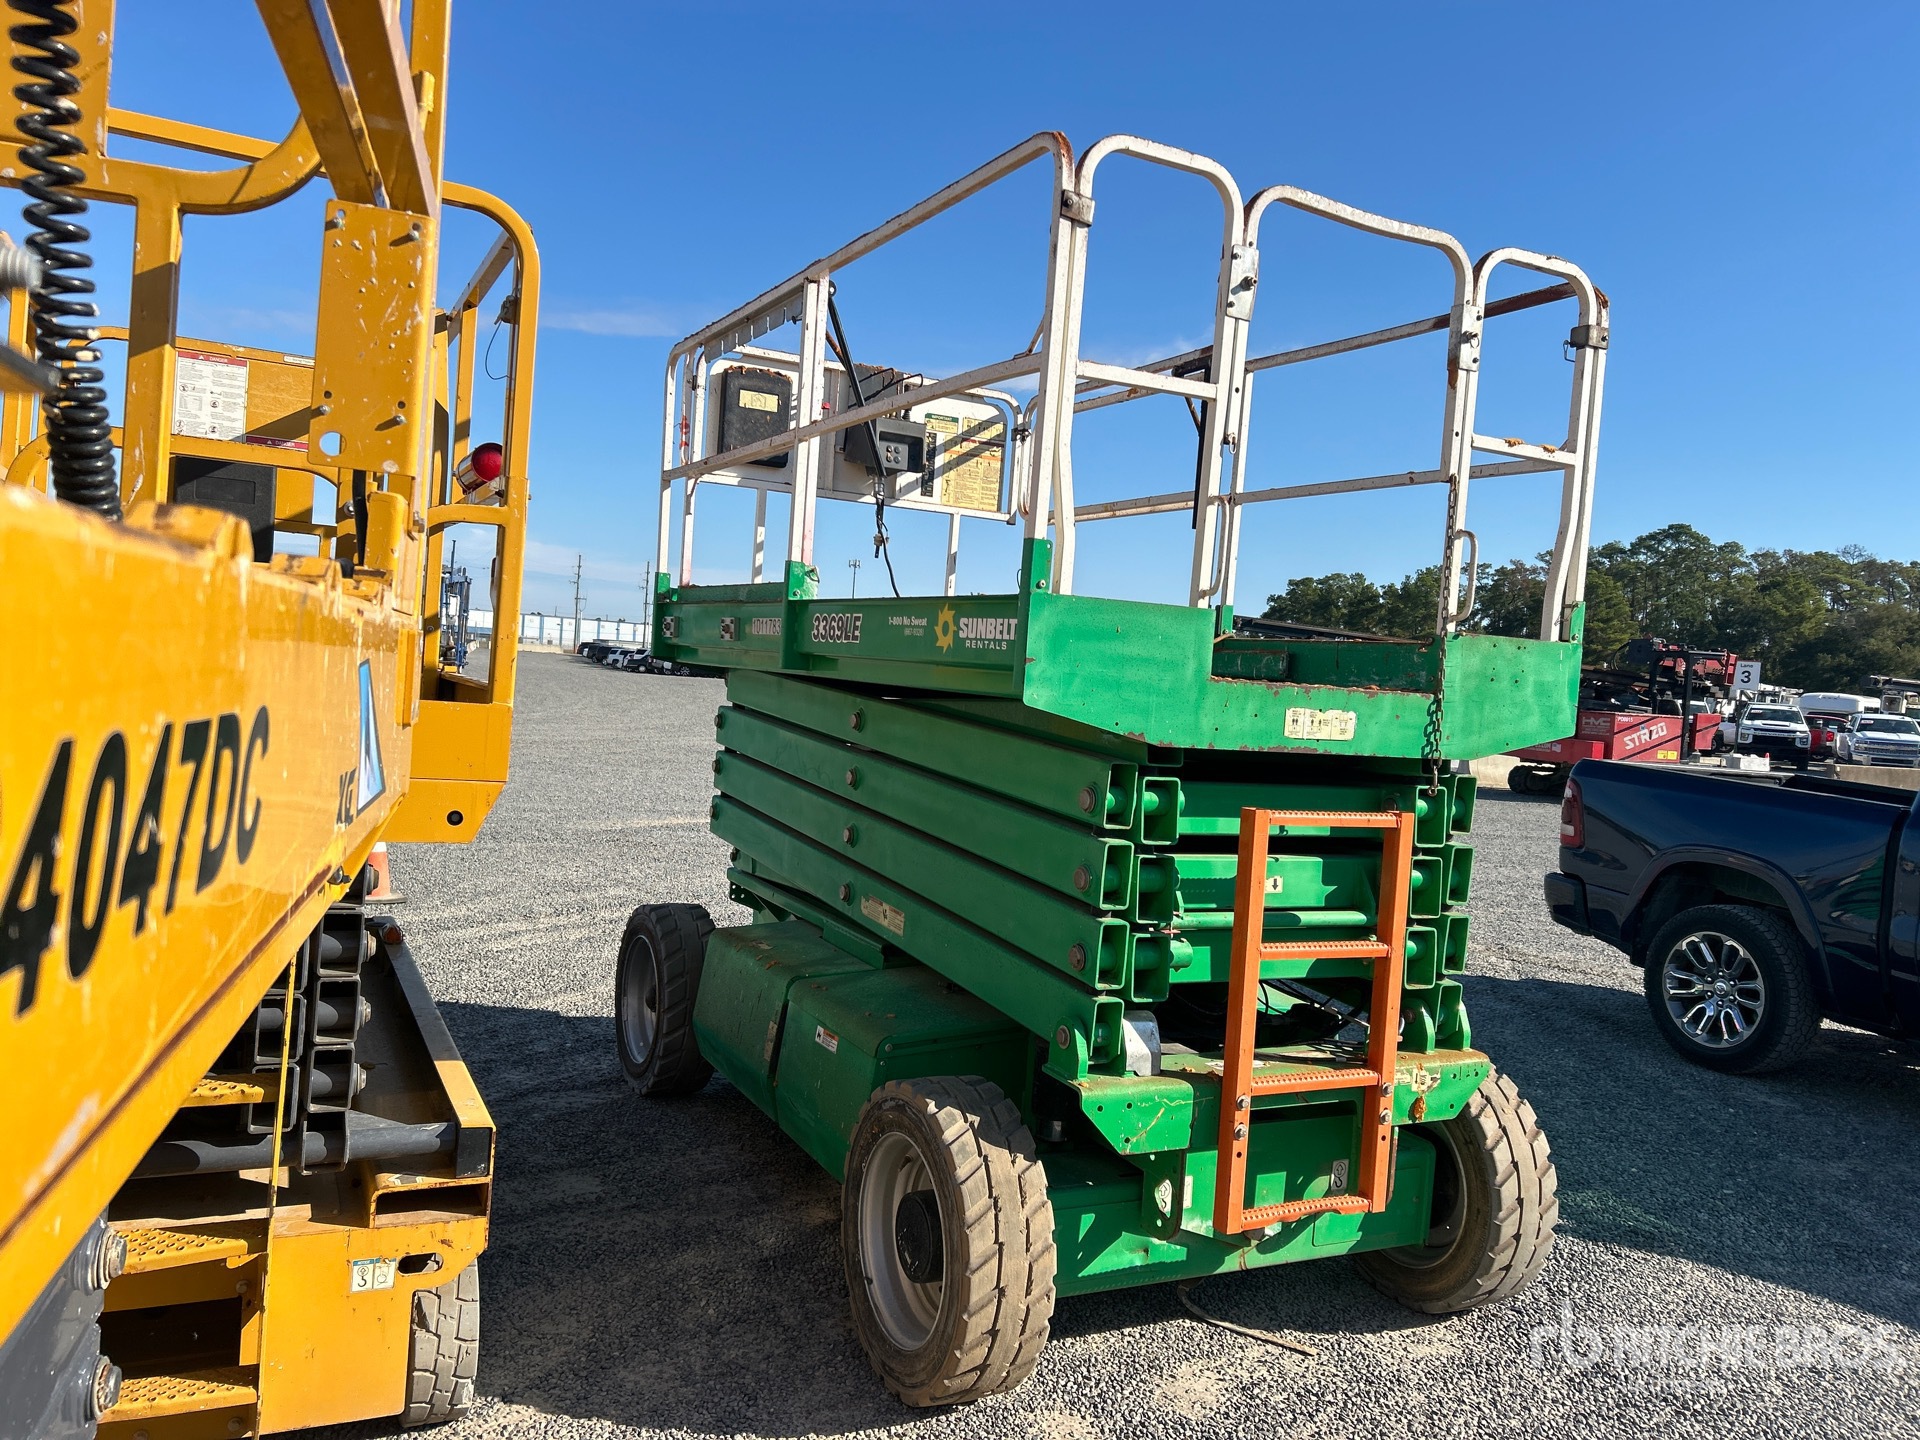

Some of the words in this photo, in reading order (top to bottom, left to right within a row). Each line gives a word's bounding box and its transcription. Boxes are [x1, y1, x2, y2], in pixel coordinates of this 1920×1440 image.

[812, 613, 862, 643] 3369LE
[889, 616, 903, 626] 1-800
[903, 616, 911, 626] No
[911, 616, 927, 626] Sweat
[959, 617, 1017, 641] SUNBELT
[965, 640, 1007, 650] RENTALS
[1741, 670, 1751, 684] 3
[0, 705, 270, 1019] 4047DC
